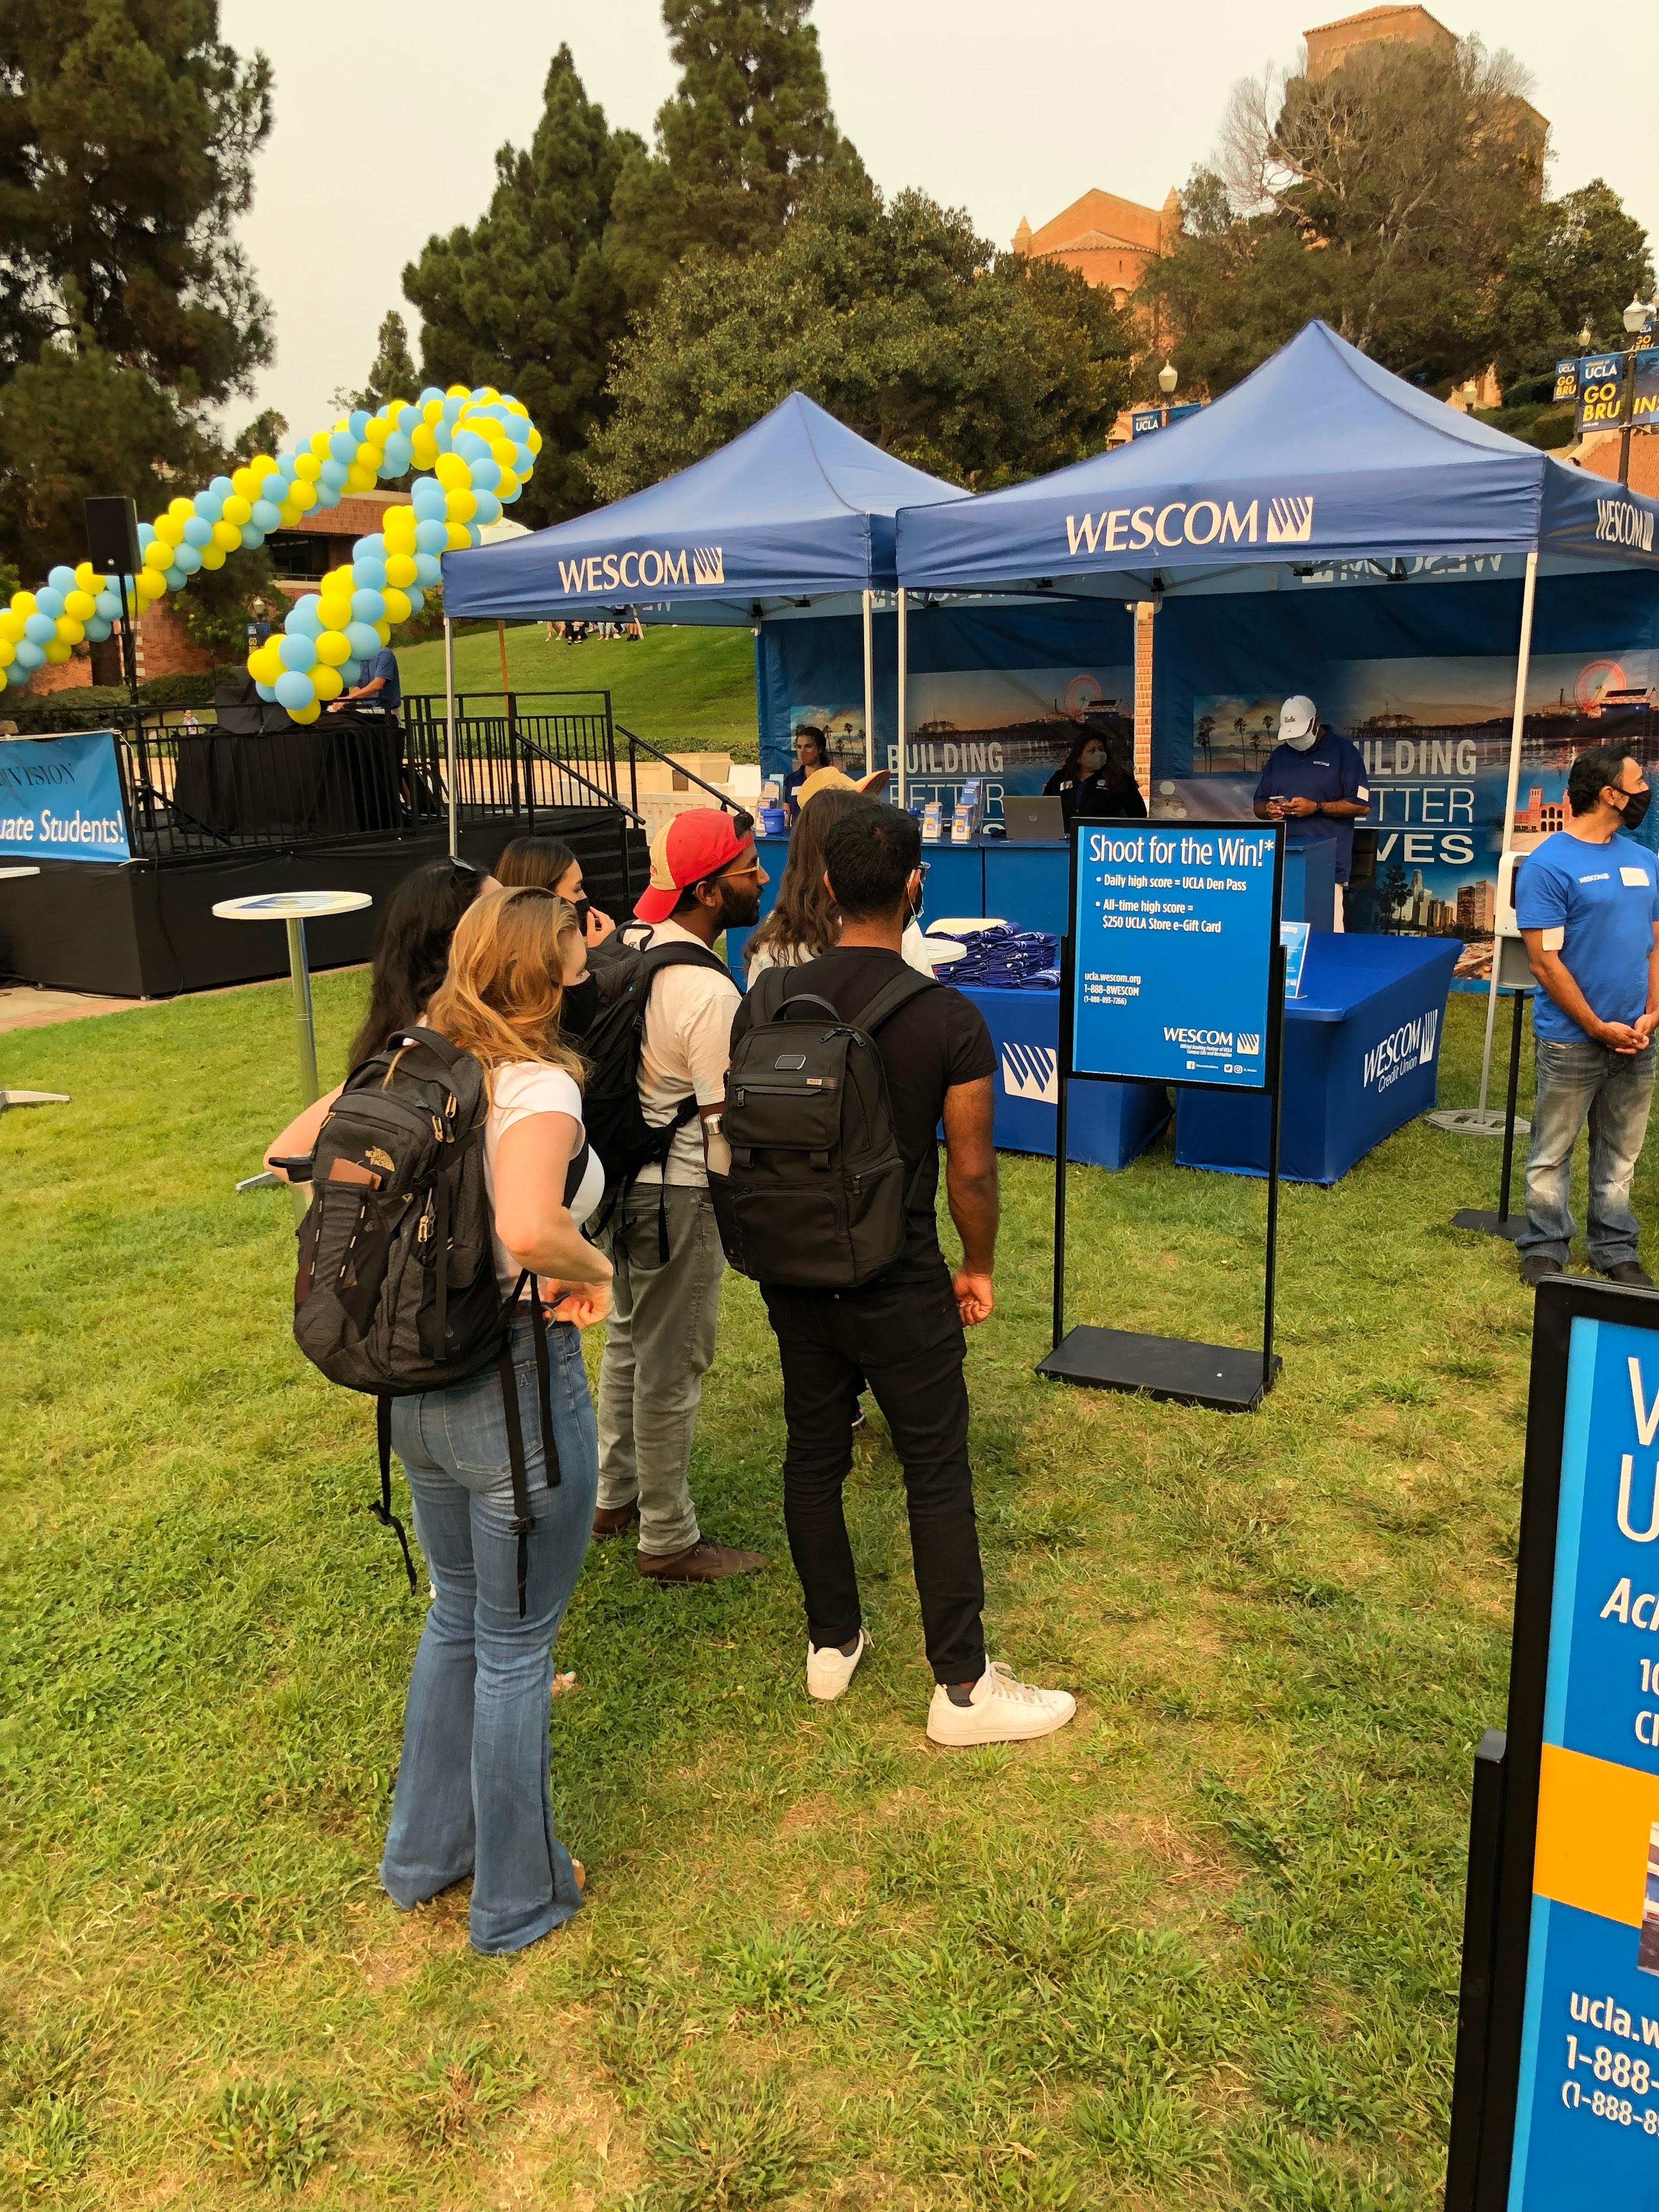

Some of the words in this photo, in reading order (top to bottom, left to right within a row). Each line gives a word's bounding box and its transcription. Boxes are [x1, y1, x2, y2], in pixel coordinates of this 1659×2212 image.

[1557, 375, 1575, 386] GO
[1585, 364, 1617, 379] UCLA
[1556, 385, 1577, 396] BRU
[1584, 383, 1616, 403] GO
[1583, 400, 1621, 422] BRU
[1633, 395, 1659, 415] IN
[1136, 419, 1159, 432] UCLA
[1065, 499, 1259, 556] WESCOM
[1595, 499, 1643, 548] WESCOM
[558, 549, 690, 594] WESCOM
[249, 637, 257, 646] GO
[887, 742, 1003, 774] BUILDING
[1354, 788, 1475, 823] TTER
[40, 809, 124, 844] Students!
[1089, 834, 1145, 863] Shoot
[1149, 836, 1177, 864] for
[1180, 837, 1212, 865] the
[1104, 874, 1126, 888] Daily
[1128, 875, 1148, 889] high
[1149, 877, 1172, 888] score
[1182, 876, 1204, 889] UCLA
[1206, 878, 1224, 890] Den
[1226, 878, 1247, 891] Pass
[1578, 873, 1604, 884] WESCOM
[1103, 899, 1139, 911] All-time
[1141, 900, 1161, 914] high
[1162, 904, 1185, 913] score
[1103, 915, 1123, 928] $250
[1125, 917, 1147, 929] UCLA
[1148, 918, 1171, 930] Store
[1173, 919, 1199, 932] e-Gift
[1201, 920, 1221, 933] Card
[1084, 972, 1141, 985] ucla.wescom.org
[1084, 984, 1139, 996] 1-888-8WESCOM
[1163, 1026, 1233, 1046] WESCOM
[1363, 1017, 1421, 1088] WESCOM
[1378, 1065, 1400, 1093] Credit
[1400, 1055, 1418, 1076] Union
